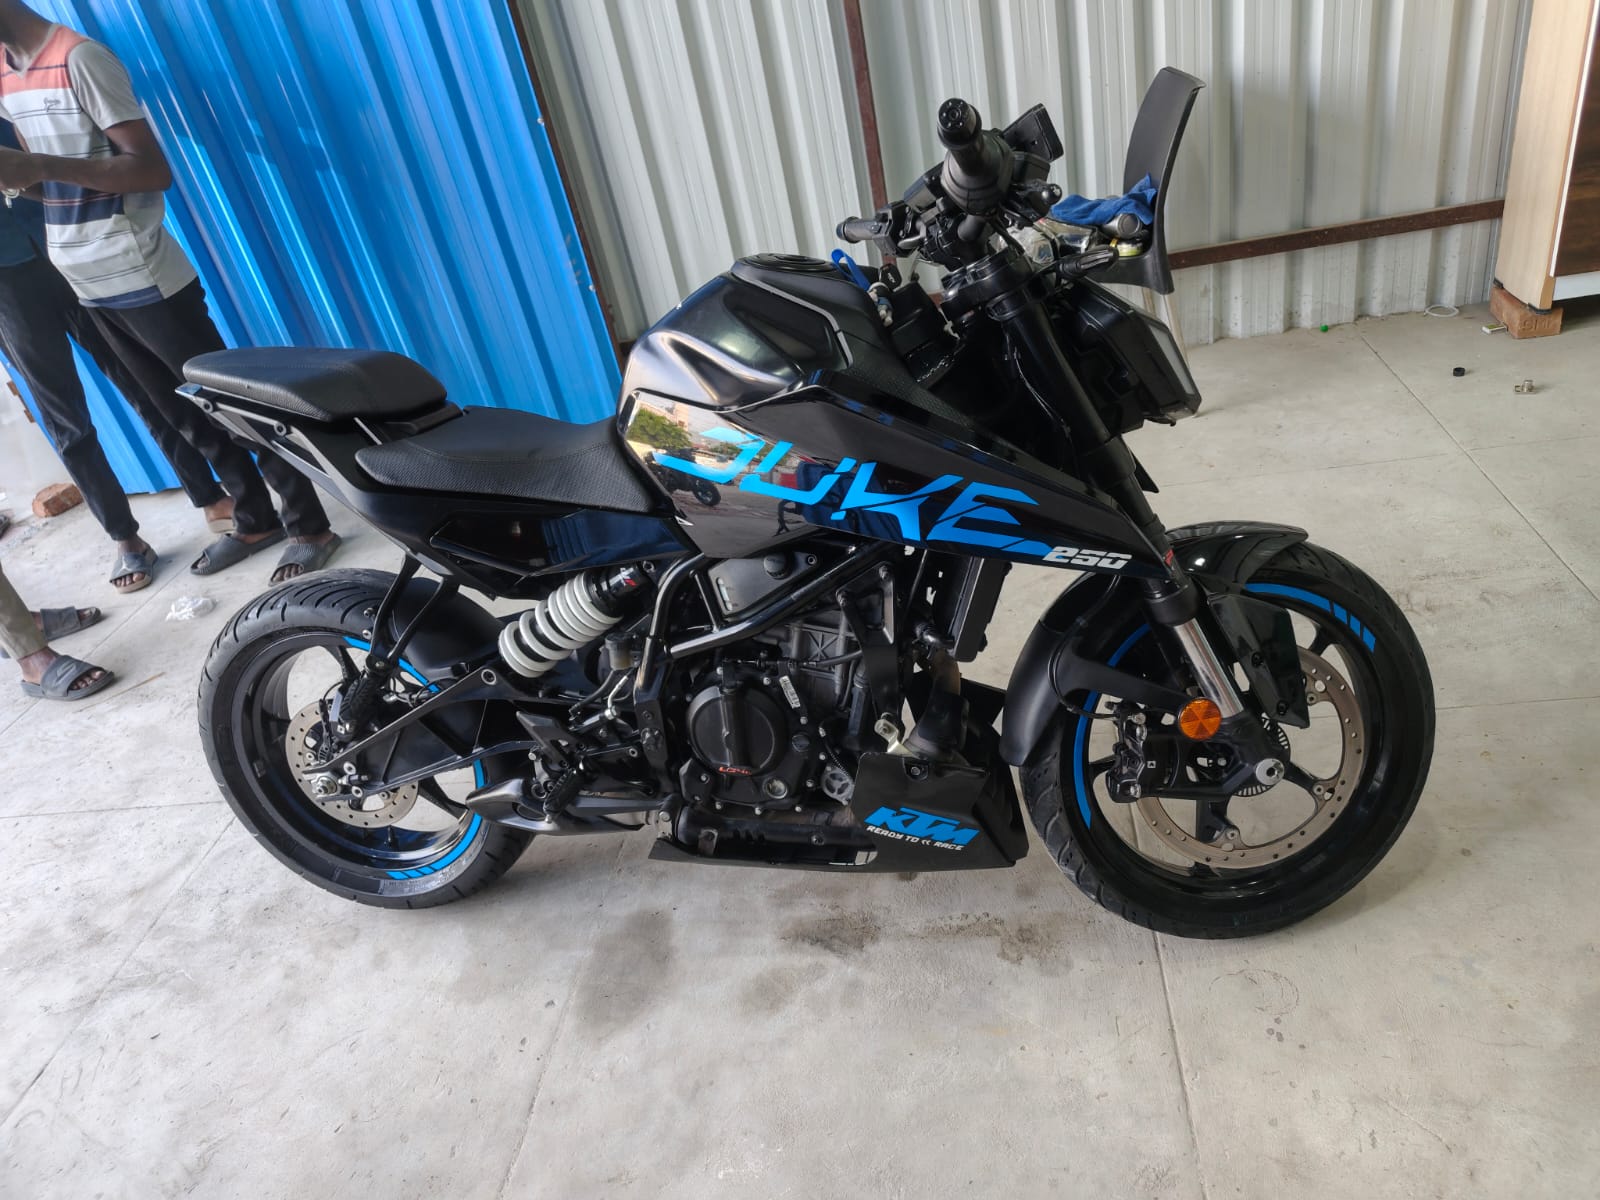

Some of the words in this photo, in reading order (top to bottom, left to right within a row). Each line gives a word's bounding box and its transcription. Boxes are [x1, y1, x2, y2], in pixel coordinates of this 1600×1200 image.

[653, 427, 1054, 558] DUKE
[1042, 545, 1133, 570] 250
[864, 806, 980, 846] KTM
[866, 825, 905, 840] READY
[905, 834, 920, 843] TO
[933, 841, 965, 851] RACE
